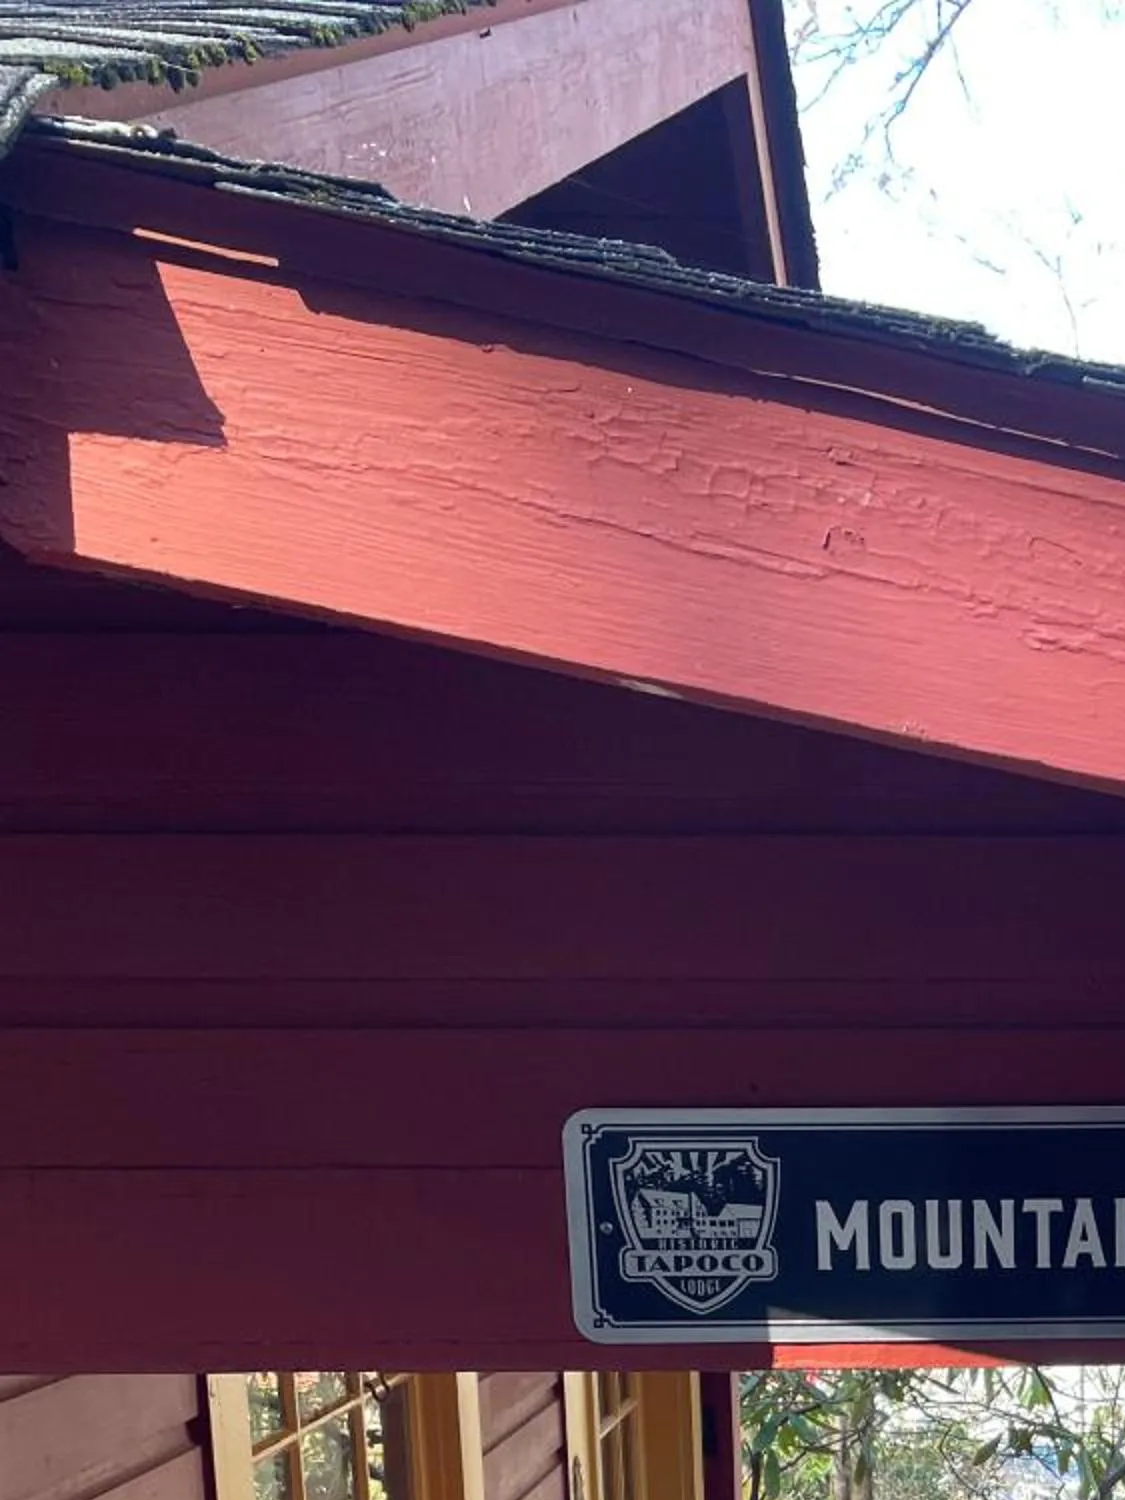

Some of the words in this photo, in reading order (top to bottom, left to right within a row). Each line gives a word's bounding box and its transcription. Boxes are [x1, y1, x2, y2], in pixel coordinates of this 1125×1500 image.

[656, 1238, 739, 1250] HISTORIC
[631, 1254, 765, 1273] TAPOCO
[679, 1278, 722, 1297] LODGE
